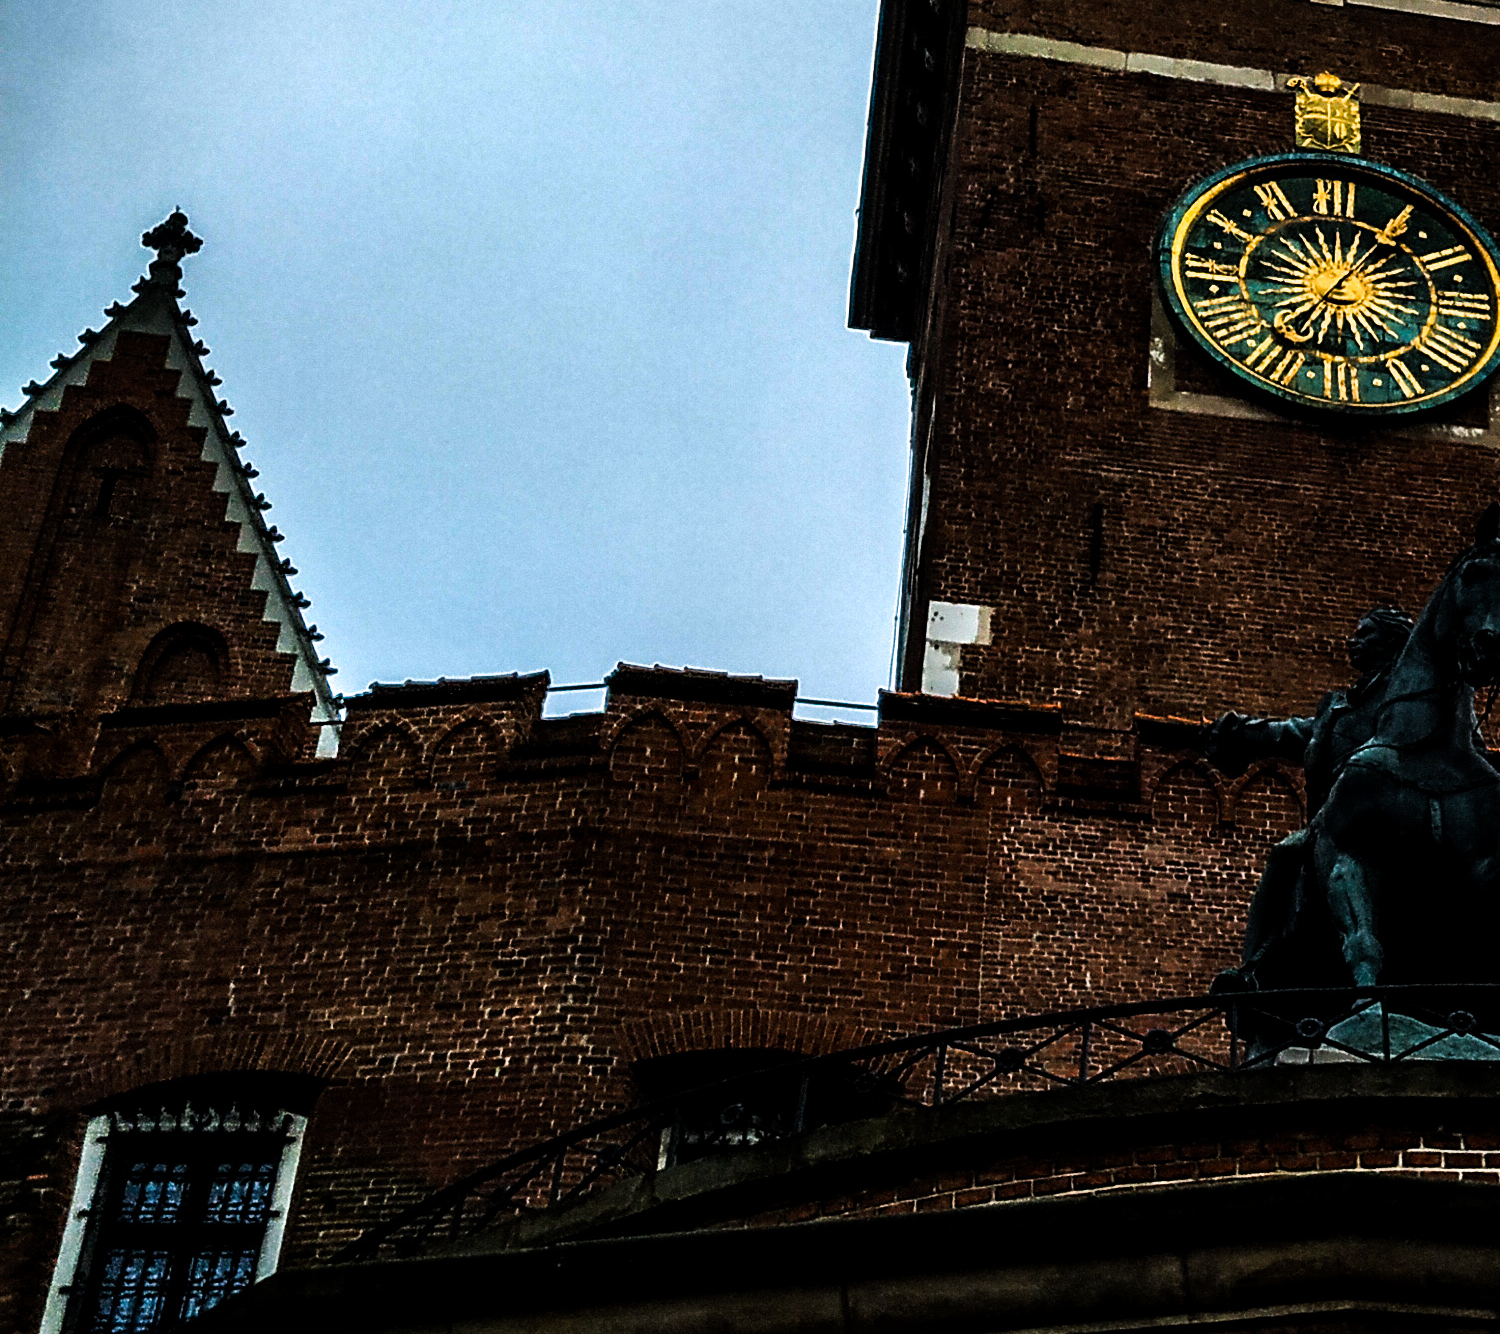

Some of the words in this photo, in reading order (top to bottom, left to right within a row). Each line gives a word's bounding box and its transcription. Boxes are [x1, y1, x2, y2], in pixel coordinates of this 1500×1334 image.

[1253, 180, 1298, 221] XI
[1312, 178, 1356, 218] XII
[1206, 208, 1253, 243] X
[1185, 252, 1240, 282] IX
[1419, 244, 1473, 272] II
[1437, 290, 1491, 320] III
[1386, 358, 1426, 398] V
